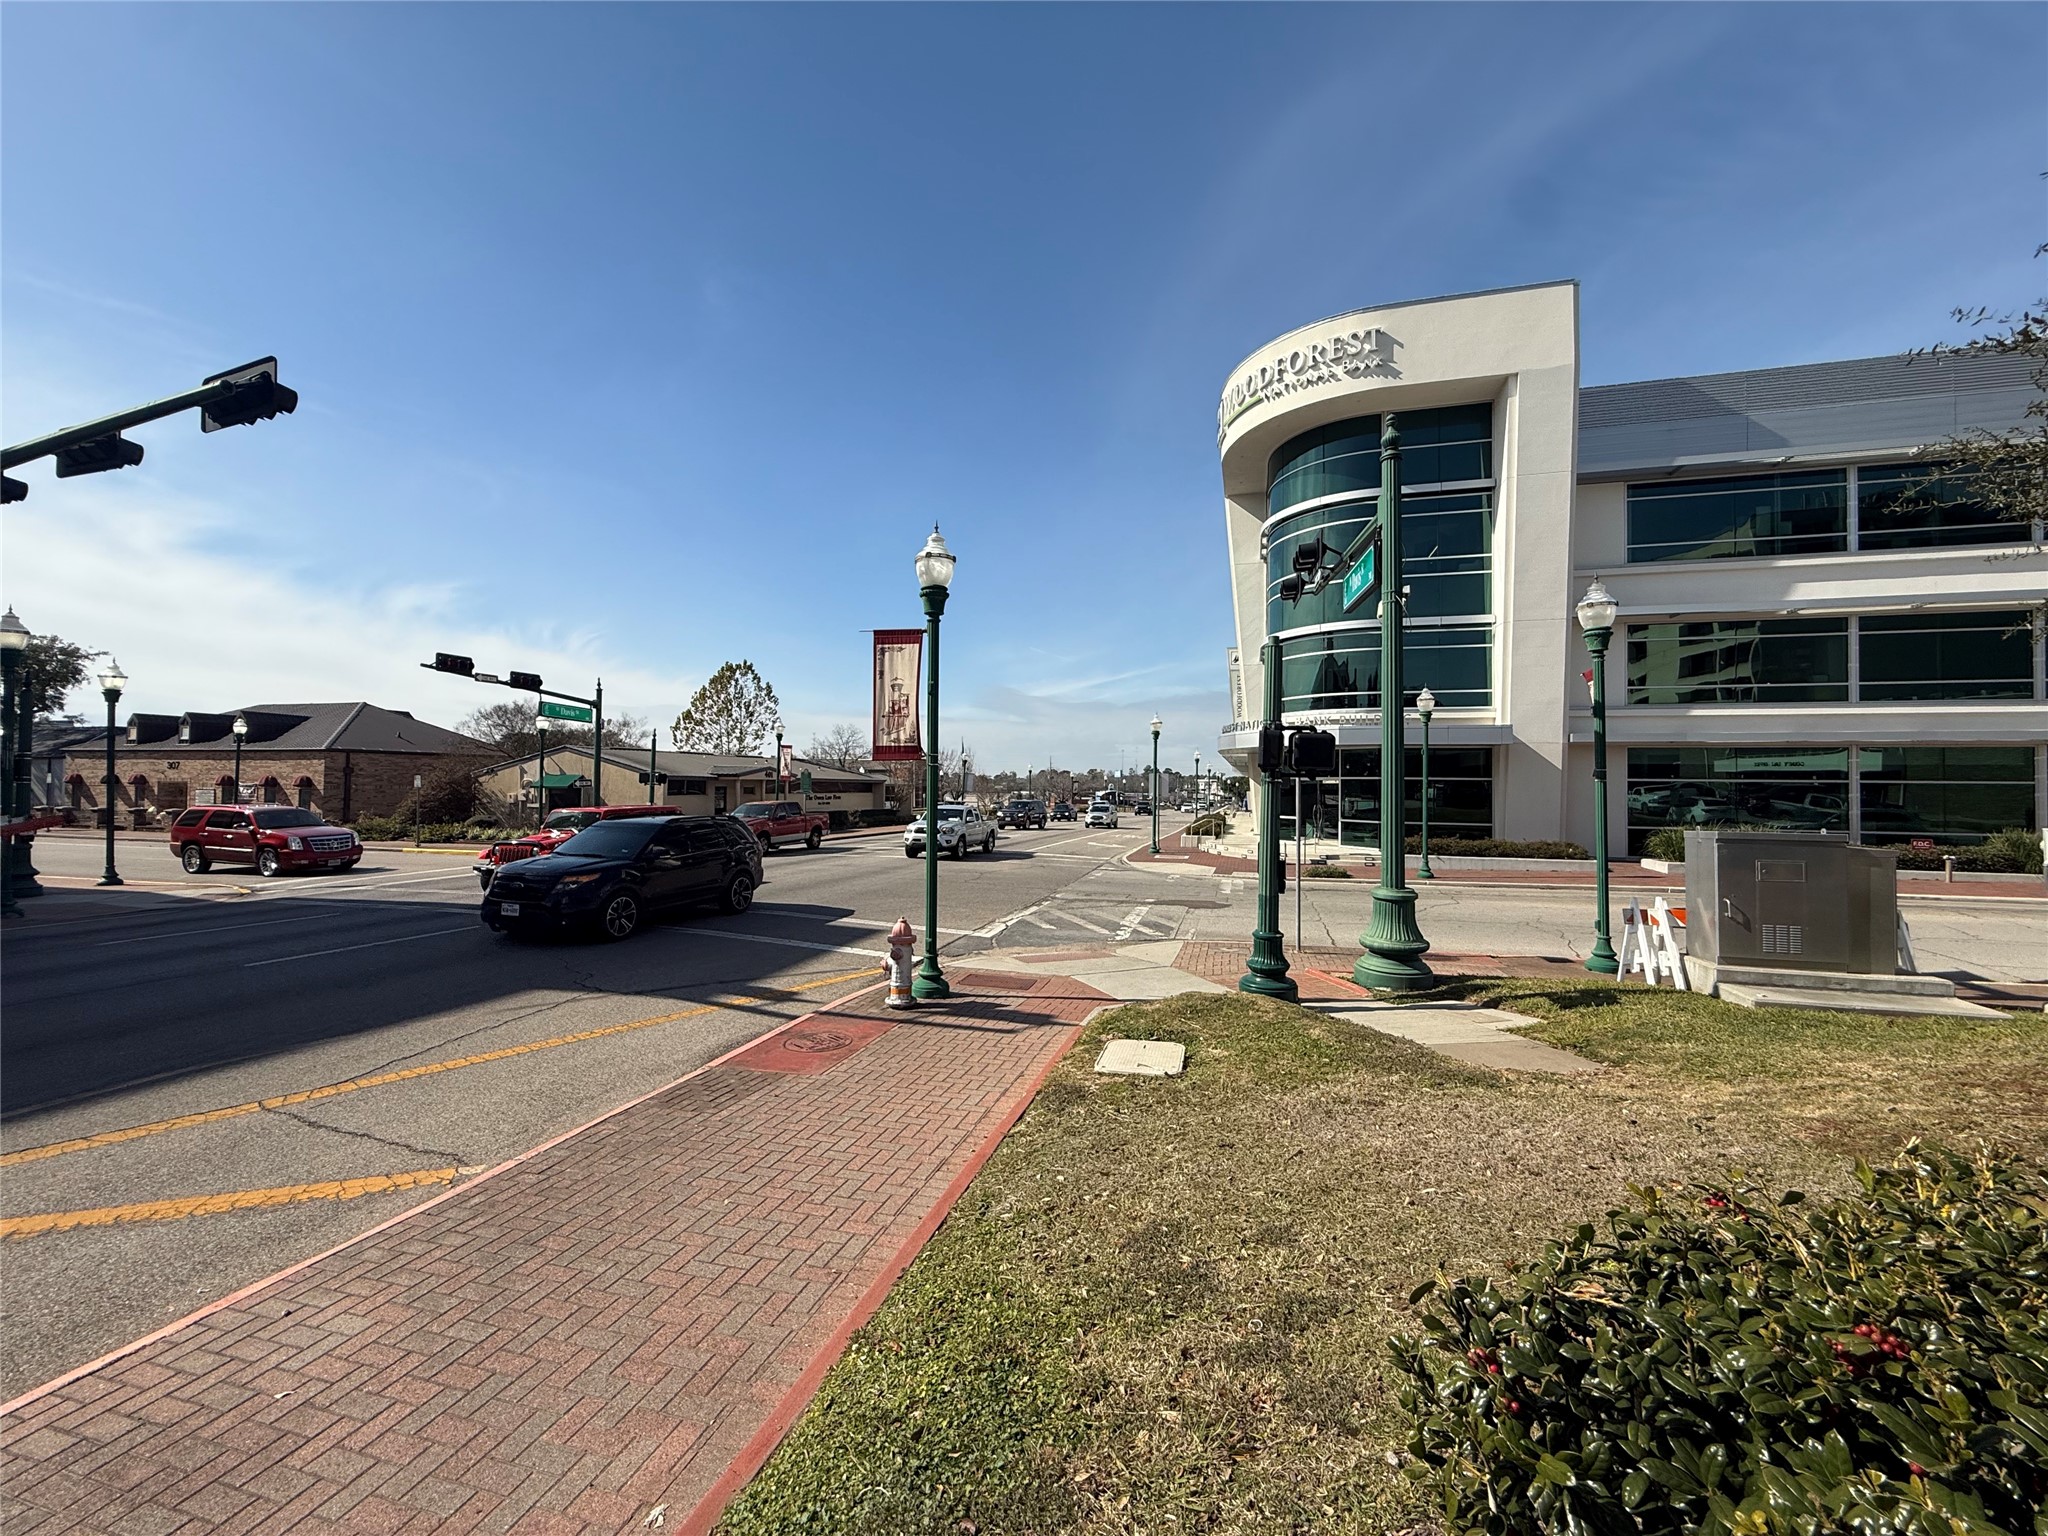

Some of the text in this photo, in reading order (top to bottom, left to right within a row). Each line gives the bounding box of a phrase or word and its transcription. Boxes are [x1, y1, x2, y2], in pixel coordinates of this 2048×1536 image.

[1342, 355, 1383, 372] BANK
[1294, 715, 1333, 726] BANK
[167, 761, 180, 769] 307
